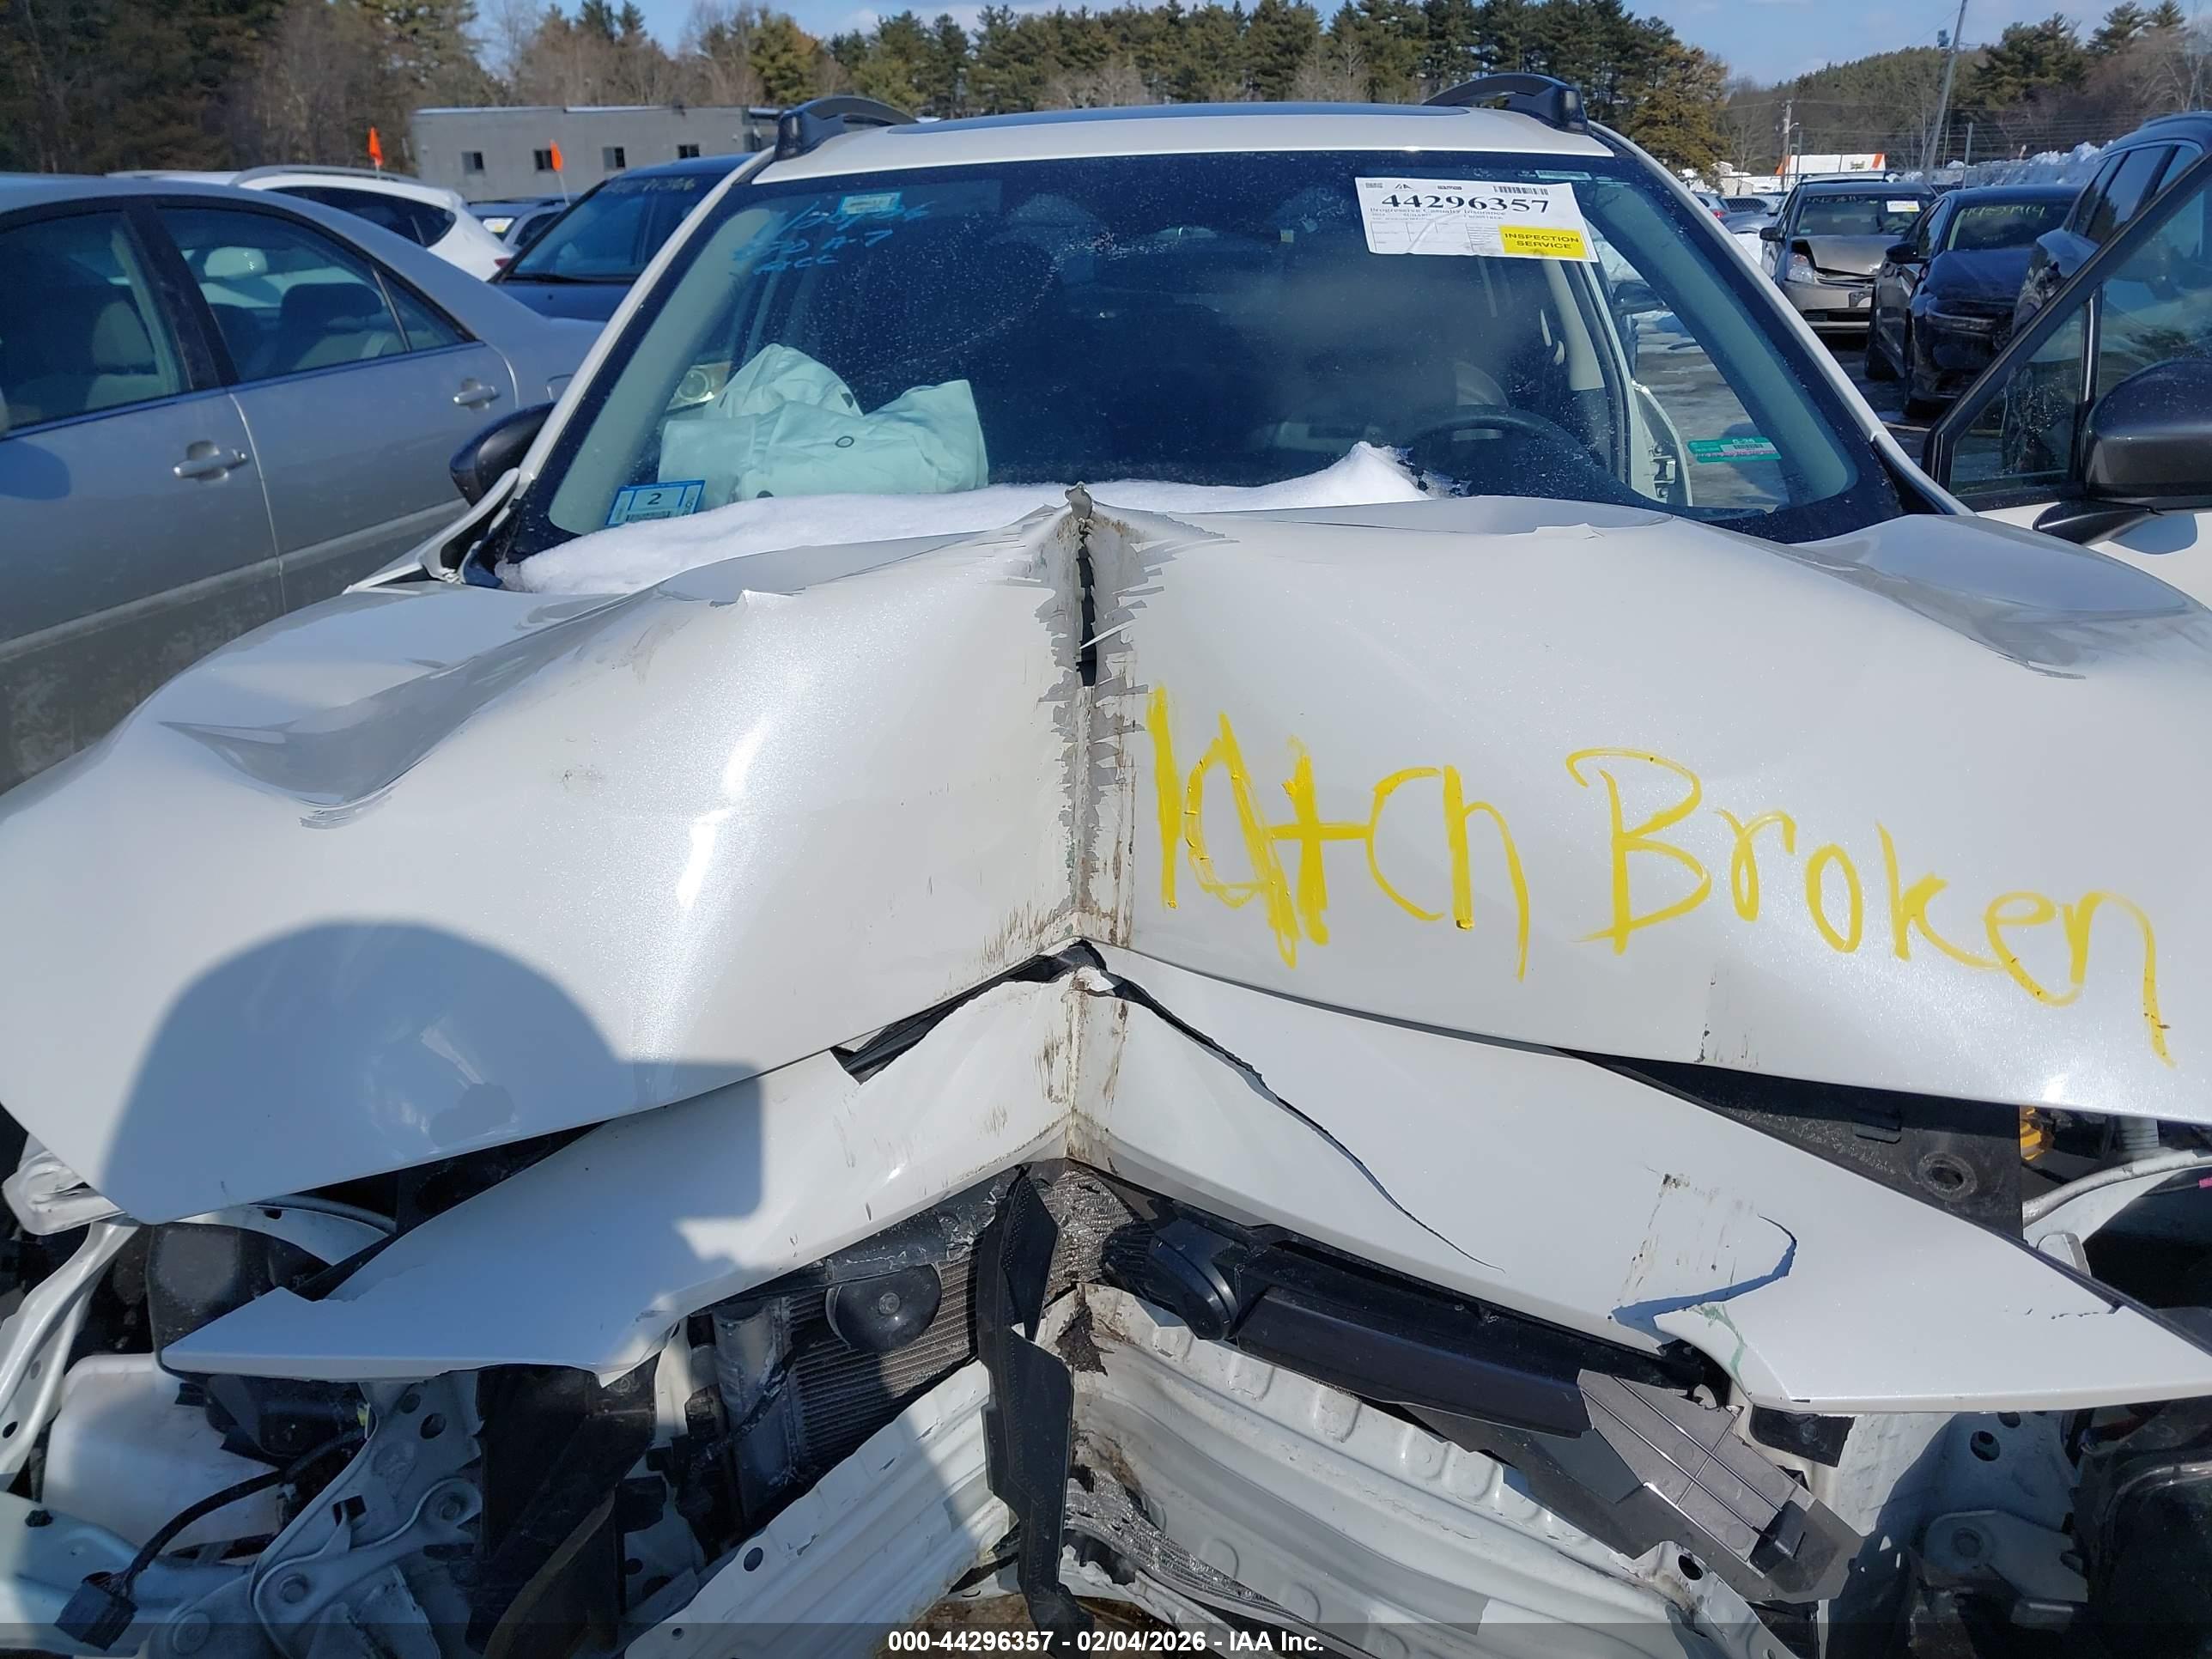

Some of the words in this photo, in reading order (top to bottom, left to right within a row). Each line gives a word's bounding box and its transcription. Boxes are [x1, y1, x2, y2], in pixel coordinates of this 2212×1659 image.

[1381, 193, 1549, 214] 44296357
[1504, 233, 1579, 243] INSPECTION
[1516, 240, 1572, 249] SERVICE
[647, 493, 662, 505] 2
[1565, 747, 2176, 1070] Broken
